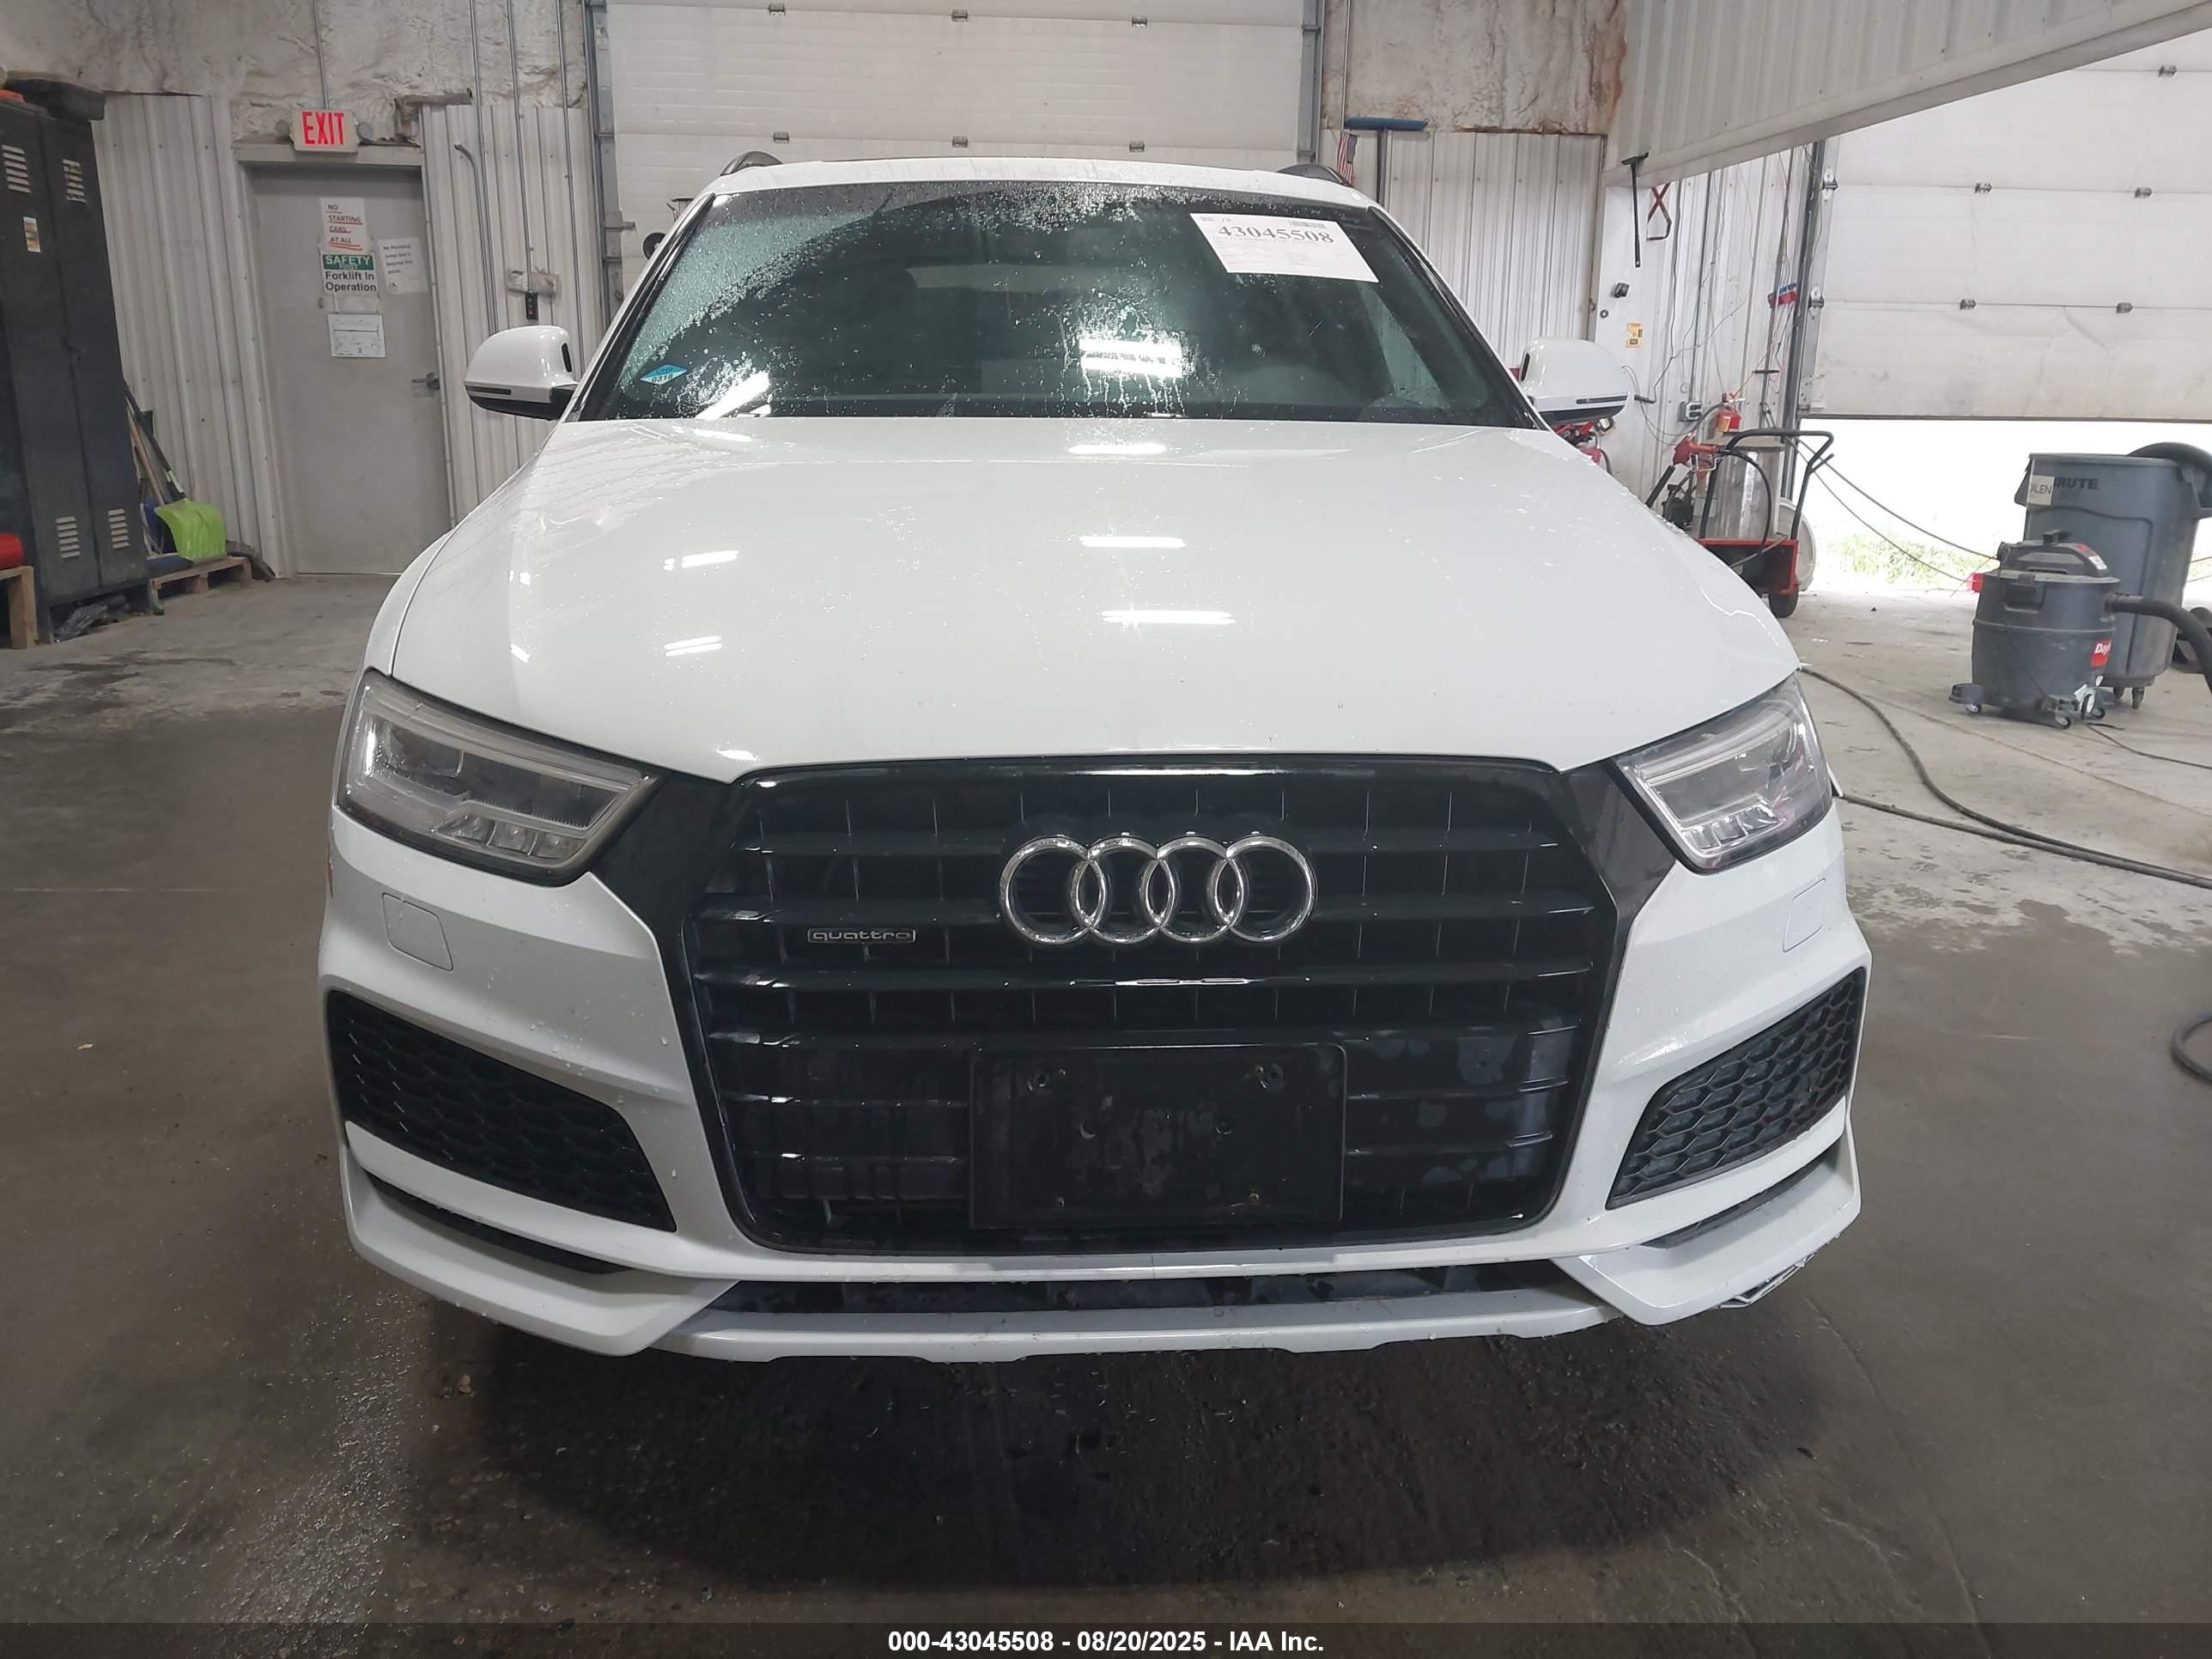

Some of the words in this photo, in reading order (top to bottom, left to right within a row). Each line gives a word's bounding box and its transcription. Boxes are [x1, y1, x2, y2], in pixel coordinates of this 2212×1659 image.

[302, 112, 343, 144] EXIT
[1218, 225, 1334, 244] 43045508
[325, 255, 370, 265] SAFETY
[325, 270, 362, 280] Forklift
[364, 271, 374, 281] In
[325, 282, 376, 292] Operation
[812, 930, 911, 942] quattro
